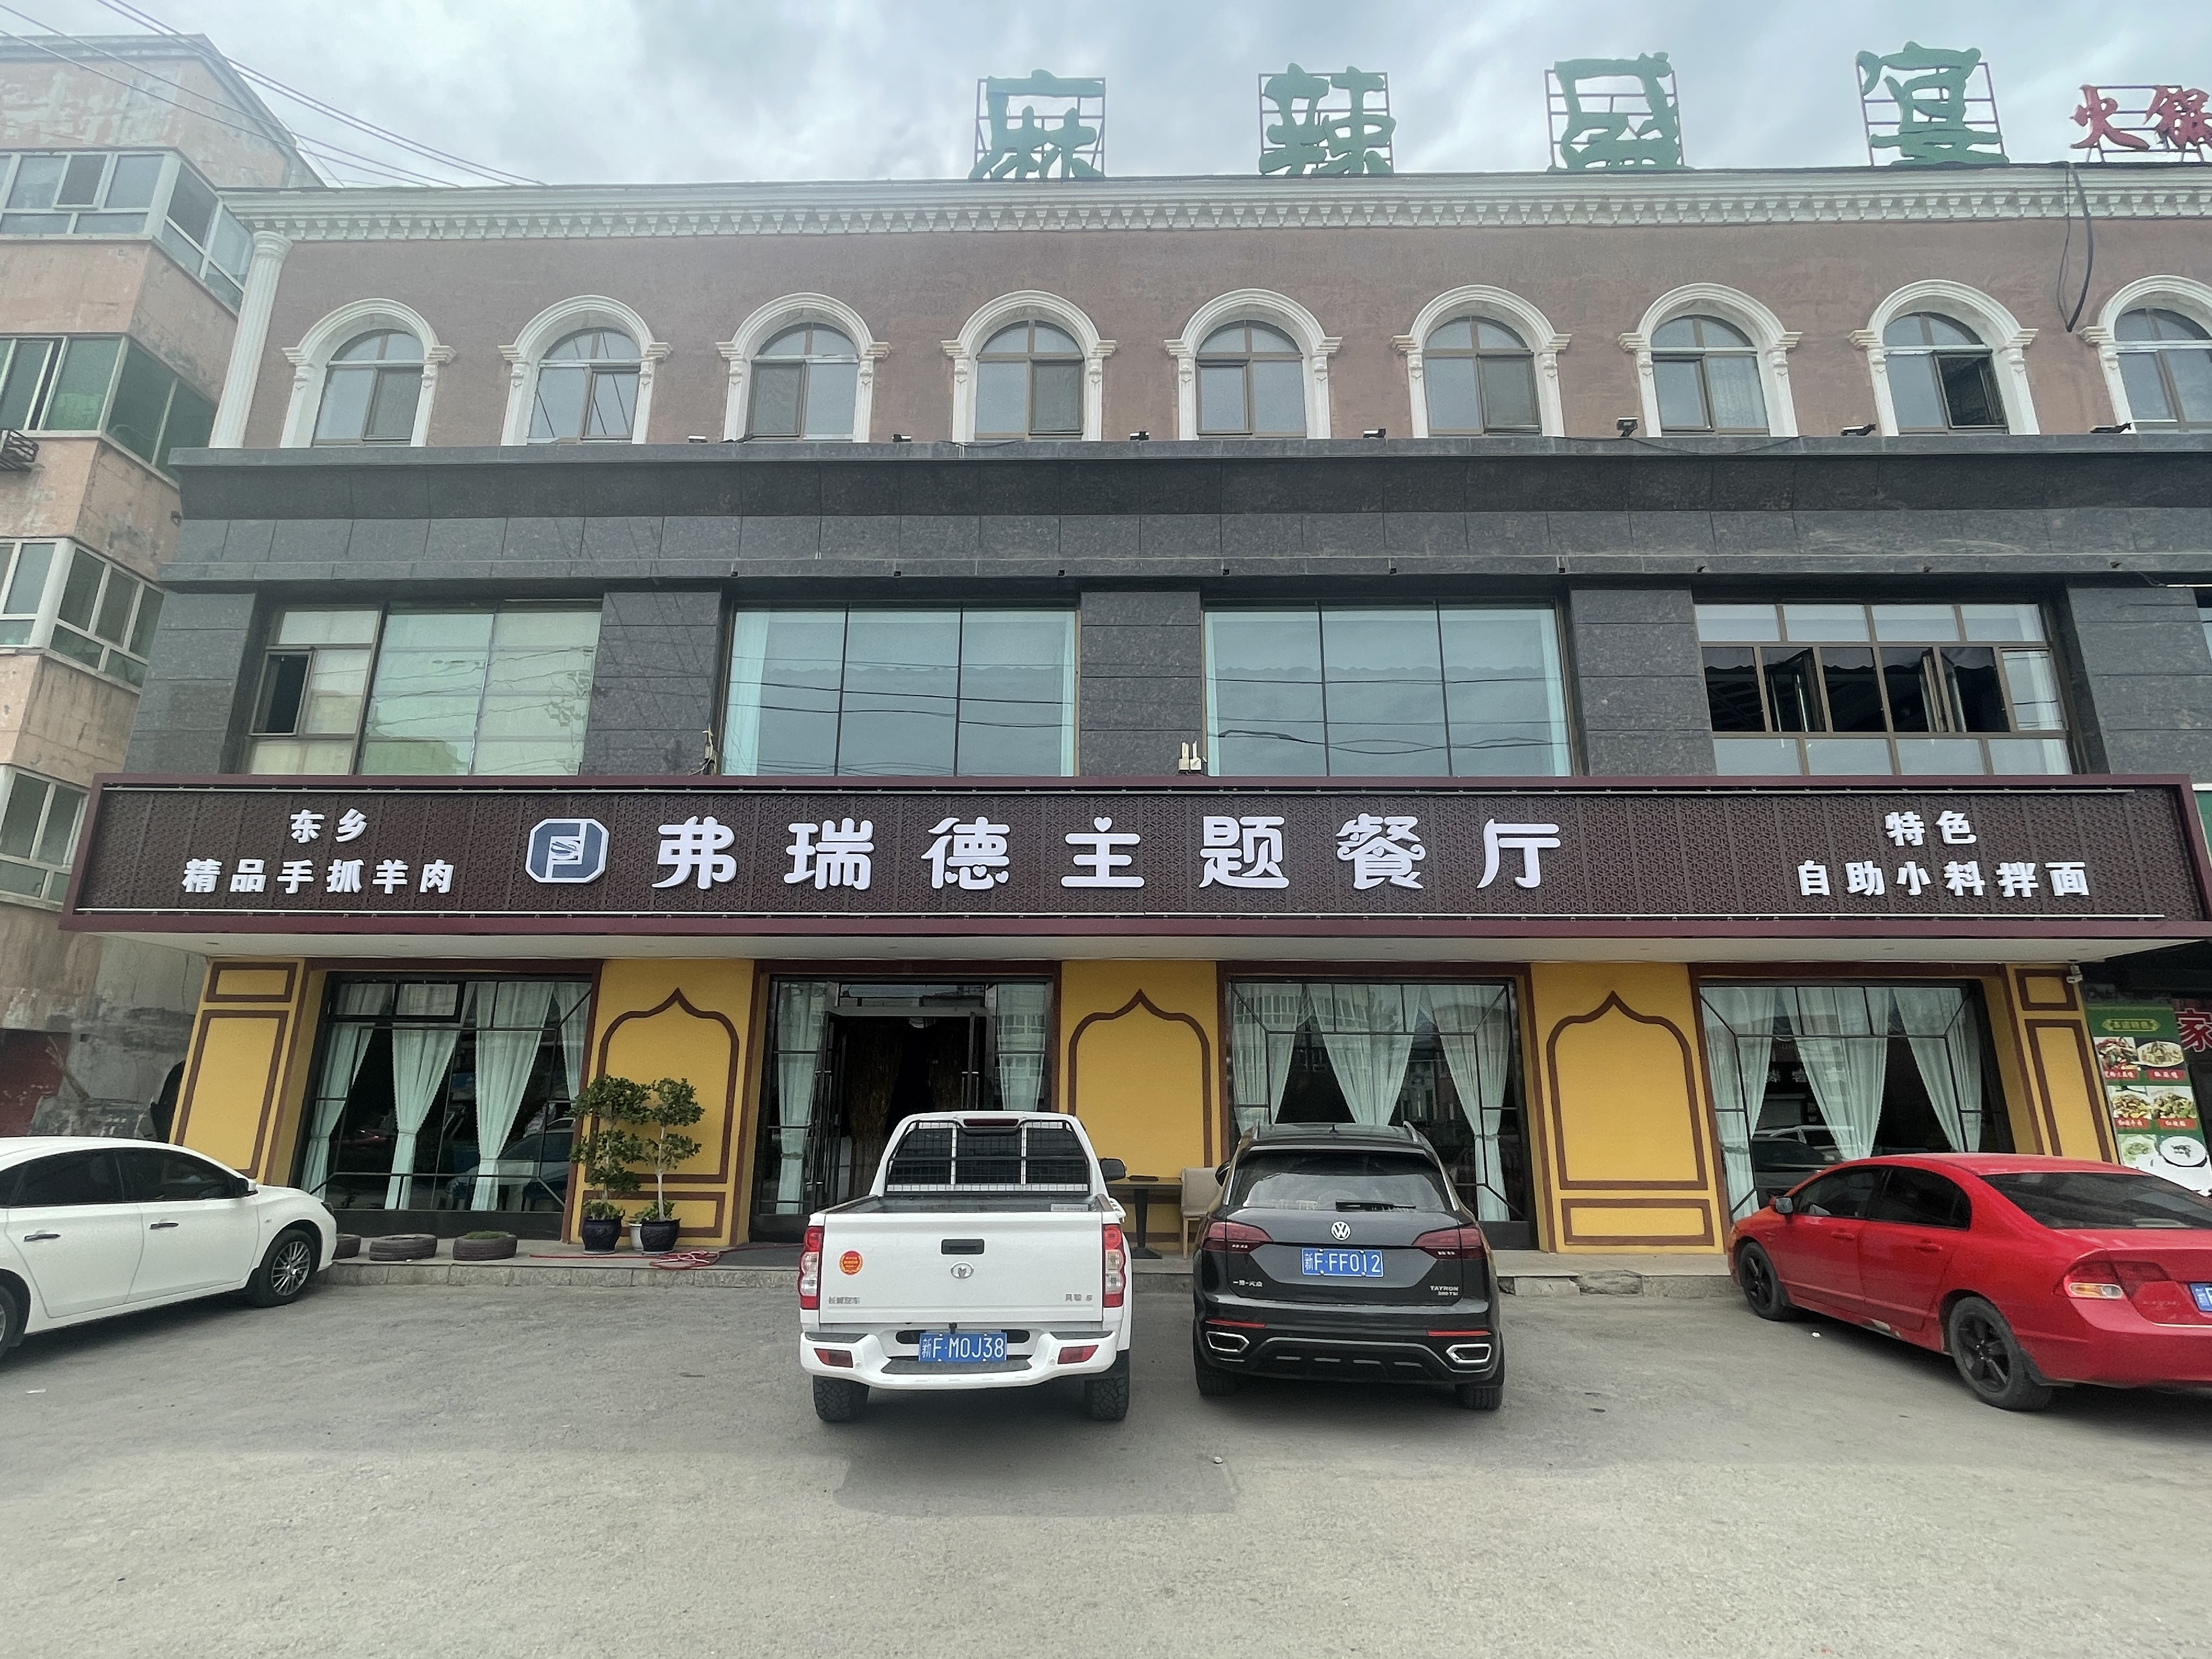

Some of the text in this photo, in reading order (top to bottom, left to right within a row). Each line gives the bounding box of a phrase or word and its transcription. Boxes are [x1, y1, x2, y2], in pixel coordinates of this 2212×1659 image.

[290, 808, 368, 843] 东乡
[1885, 810, 1977, 847] 特色
[651, 813, 1561, 890] 弗瑞德主题餐厅
[181, 858, 454, 894] 精品手抓羊肉
[1797, 860, 2090, 898] 自助小料拌面
[2174, 1007, 2212, 1053] 家
